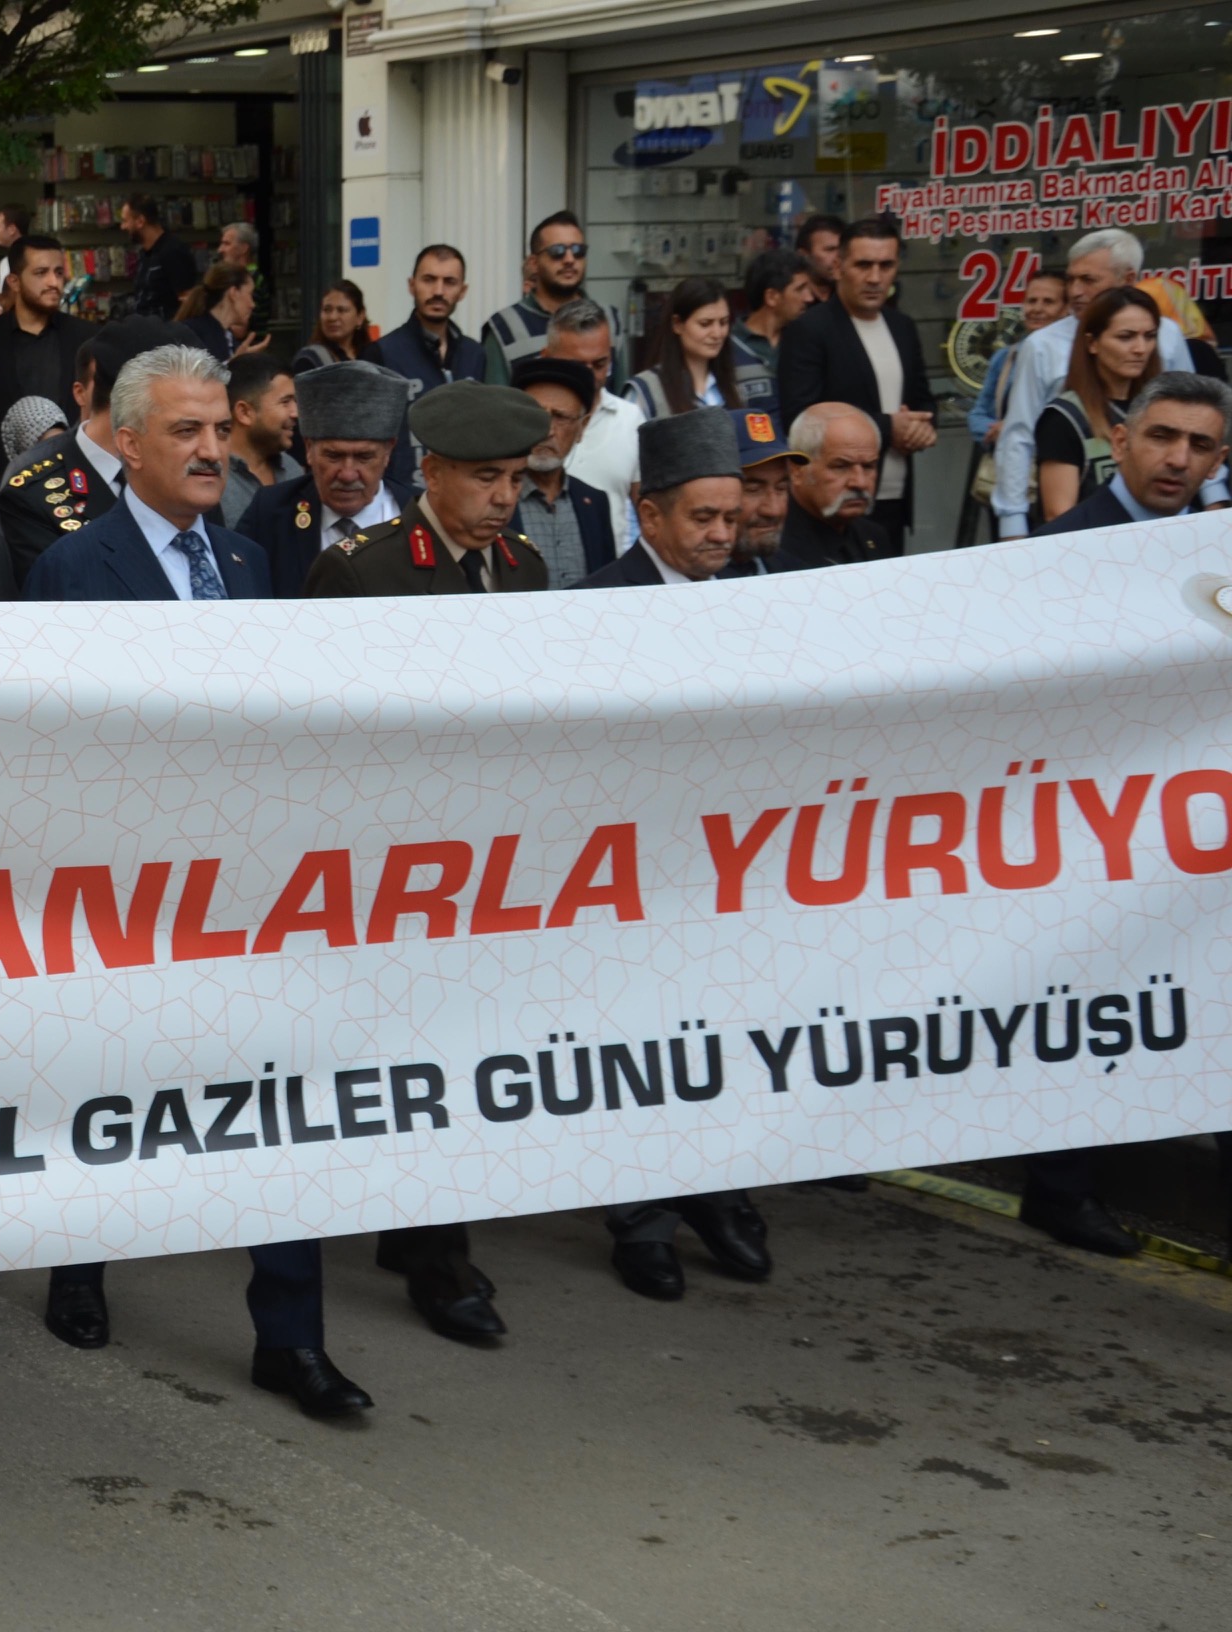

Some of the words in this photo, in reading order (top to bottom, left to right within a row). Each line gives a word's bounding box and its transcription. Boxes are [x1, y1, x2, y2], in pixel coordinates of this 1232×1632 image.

[901, 208, 945, 245] Hiç
[1081, 192, 1161, 229] Kredi
[1040, 161, 1189, 201] Bakmadan
[701, 758, 1232, 914] YÜRÜYO
[71, 1061, 450, 1162] GAZİLER
[473, 1019, 725, 1124] GÜNÜ
[747, 973, 1189, 1094] YÜRÜYÜŞÜ
